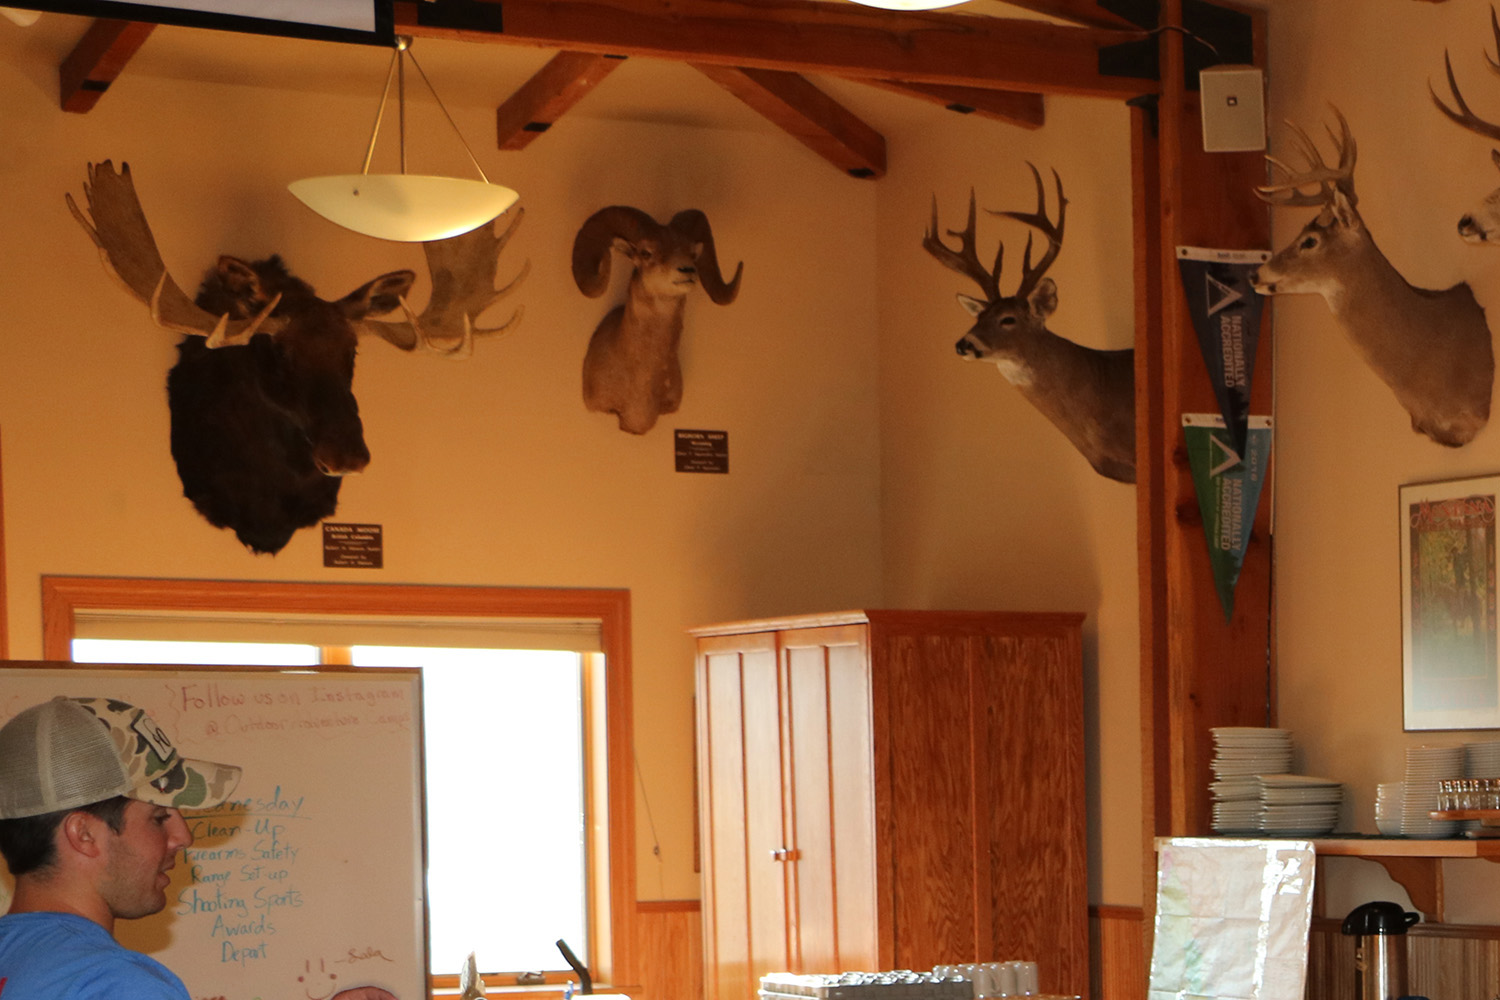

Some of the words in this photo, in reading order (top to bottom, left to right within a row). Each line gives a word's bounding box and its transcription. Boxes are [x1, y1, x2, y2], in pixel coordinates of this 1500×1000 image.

[1221, 314, 1234, 388] ACCREDITED
[1232, 315, 1245, 387] NATIONALLY
[1221, 476, 1232, 551] ACCREDITED
[1232, 478, 1243, 551] NATIONALLY
[181, 684, 246, 712] Follow
[251, 839, 299, 864] Safety
[191, 864, 231, 888] Range
[177, 888, 249, 918] Shooting
[254, 886, 304, 915] Sports
[211, 914, 277, 937] Awards
[221, 940, 268, 967] Depart
